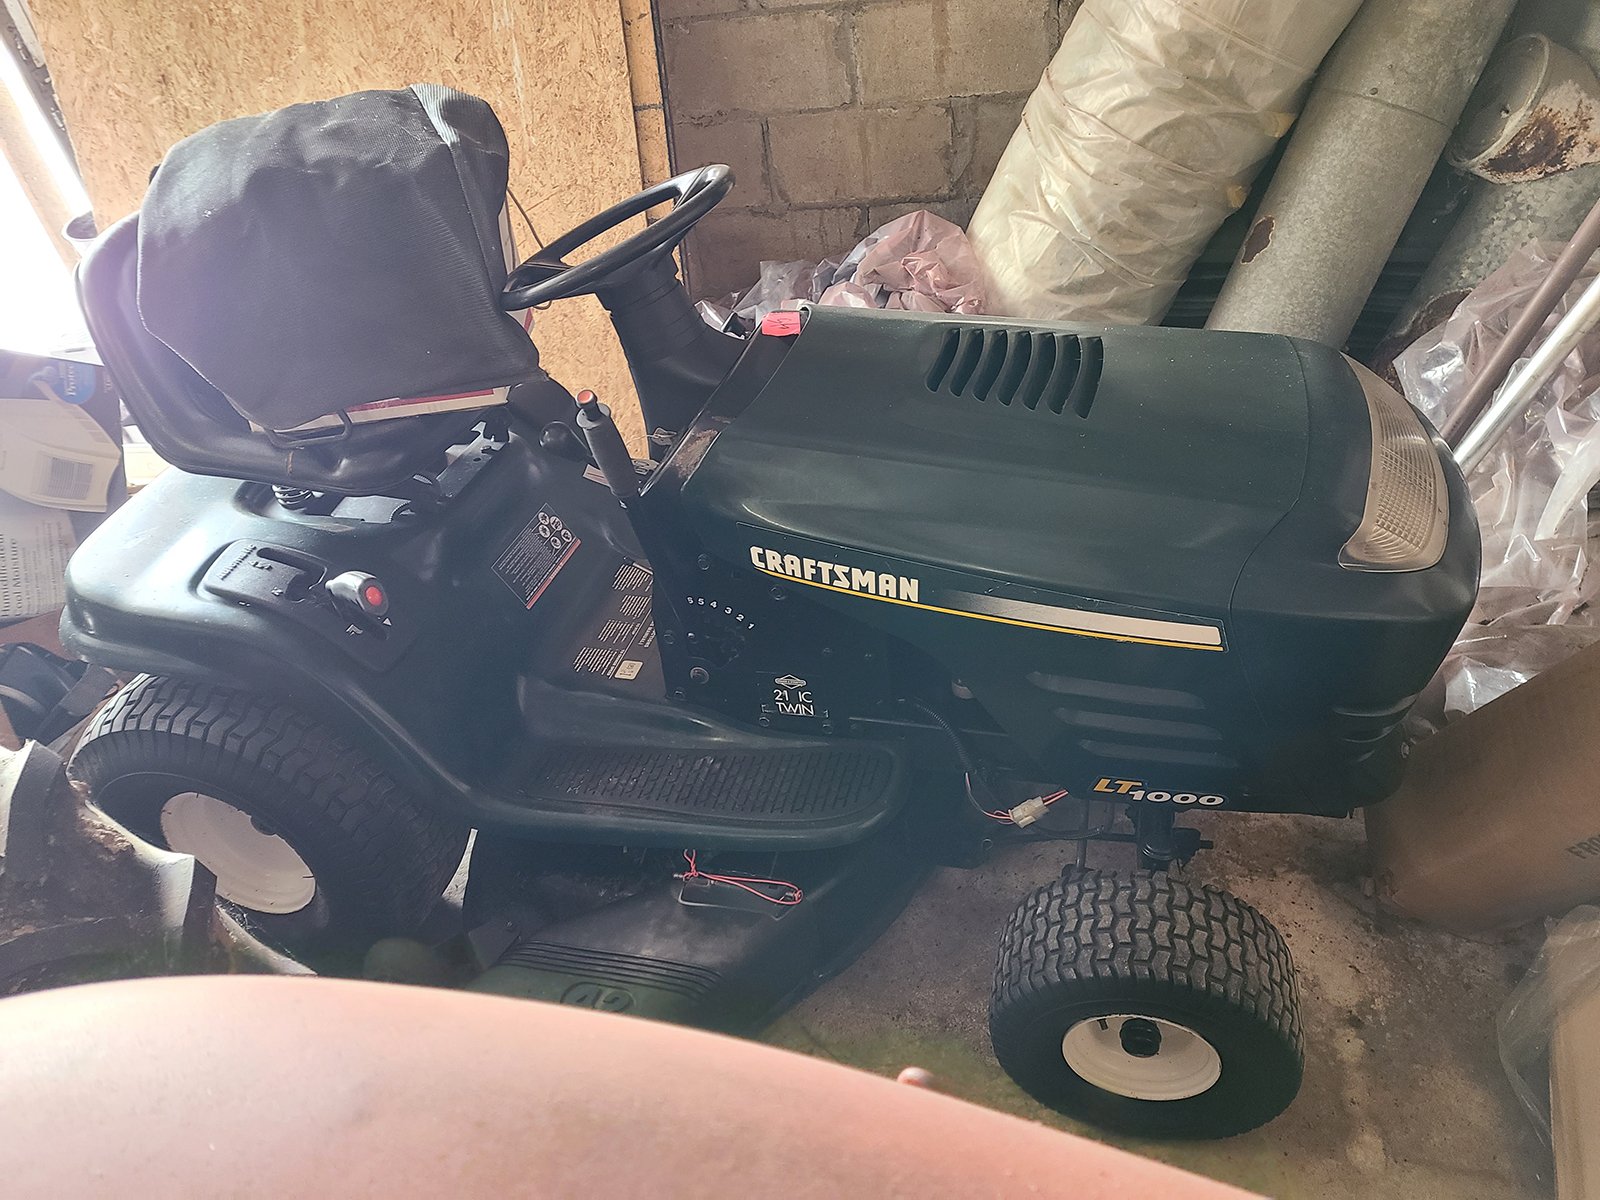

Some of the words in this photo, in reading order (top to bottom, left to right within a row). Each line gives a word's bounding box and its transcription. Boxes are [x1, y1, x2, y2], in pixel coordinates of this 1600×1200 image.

[749, 545, 919, 603] CRAFTSMAN
[724, 606, 733, 614] 3
[736, 613, 745, 622] 2
[773, 689, 789, 701] 21
[775, 702, 814, 716] TWIN
